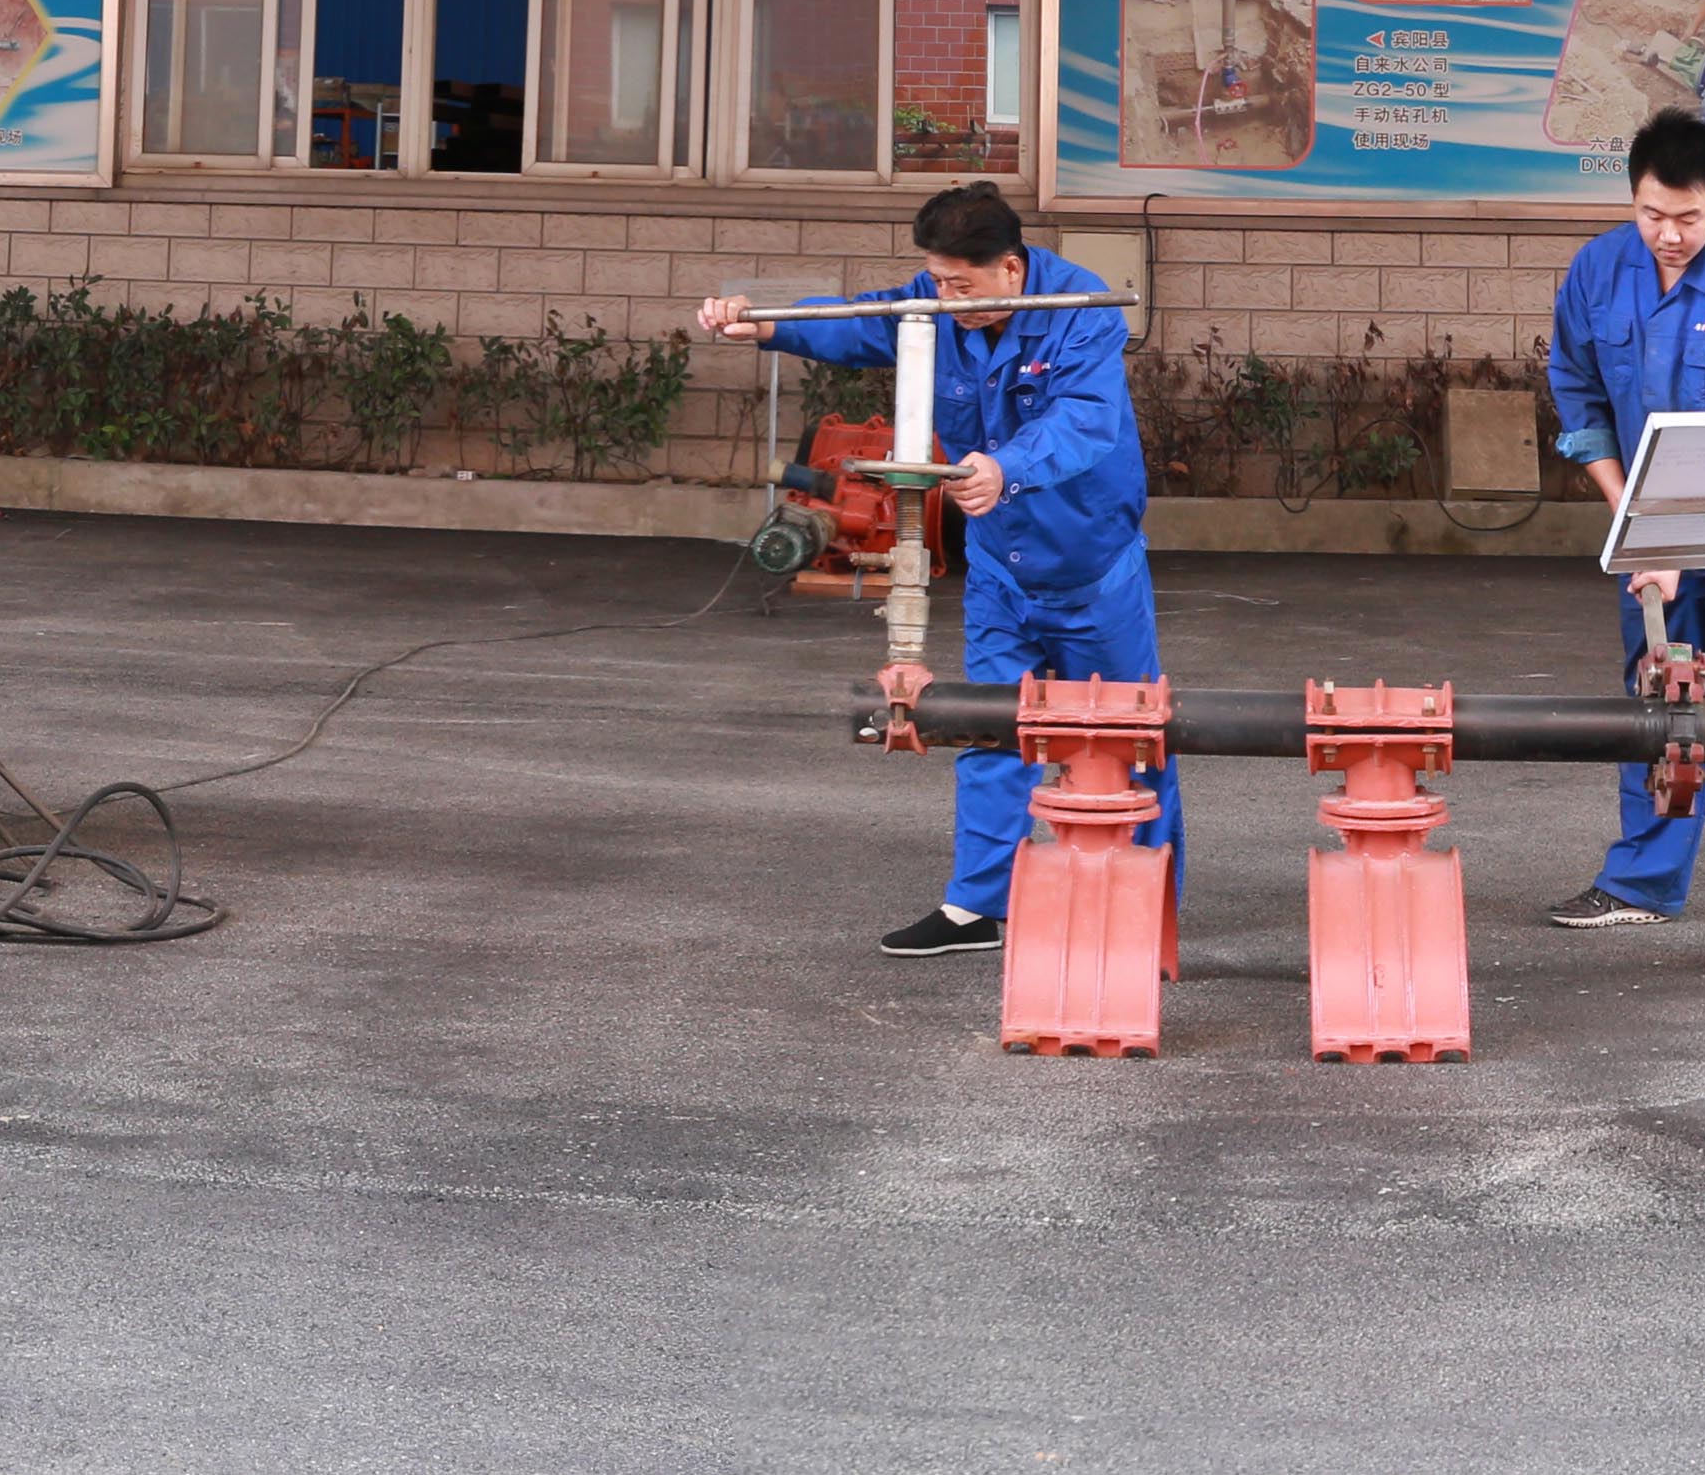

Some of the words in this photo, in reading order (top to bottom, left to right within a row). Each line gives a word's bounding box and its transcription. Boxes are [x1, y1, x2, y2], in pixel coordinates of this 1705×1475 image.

[1392, 30, 1448, 48] 宾阳县
[1355, 55, 1448, 73] 自来水公司
[1353, 81, 1427, 97] ZG2-50
[1433, 82, 1450, 98] 型
[1354, 106, 1448, 124] 手动钻孔机
[1353, 131, 1429, 149] 使用现场
